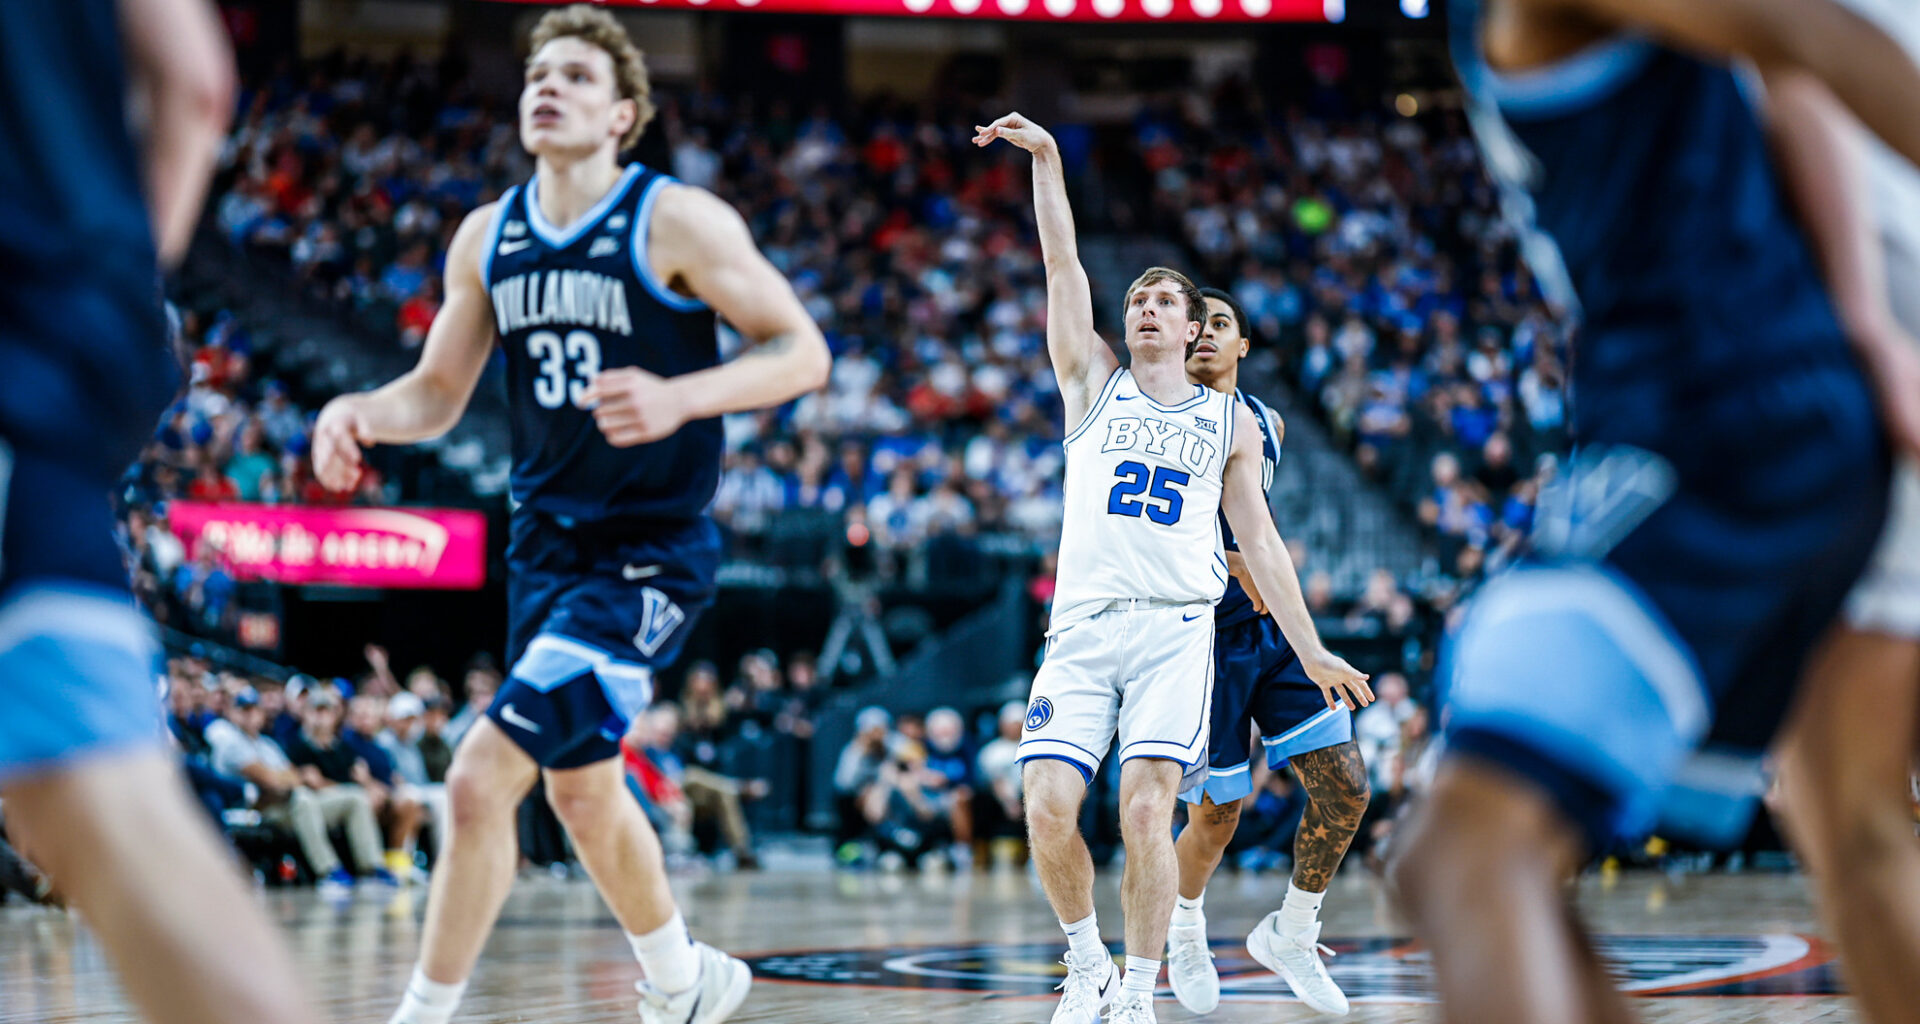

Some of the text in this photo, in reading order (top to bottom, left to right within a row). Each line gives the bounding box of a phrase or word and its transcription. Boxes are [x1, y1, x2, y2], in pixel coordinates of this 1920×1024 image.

[491, 269, 632, 337] VILLANOVA
[526, 330, 601, 410] 33
[1101, 417, 1216, 477] BYU
[1107, 460, 1190, 526] 25
[633, 586, 686, 658] V
